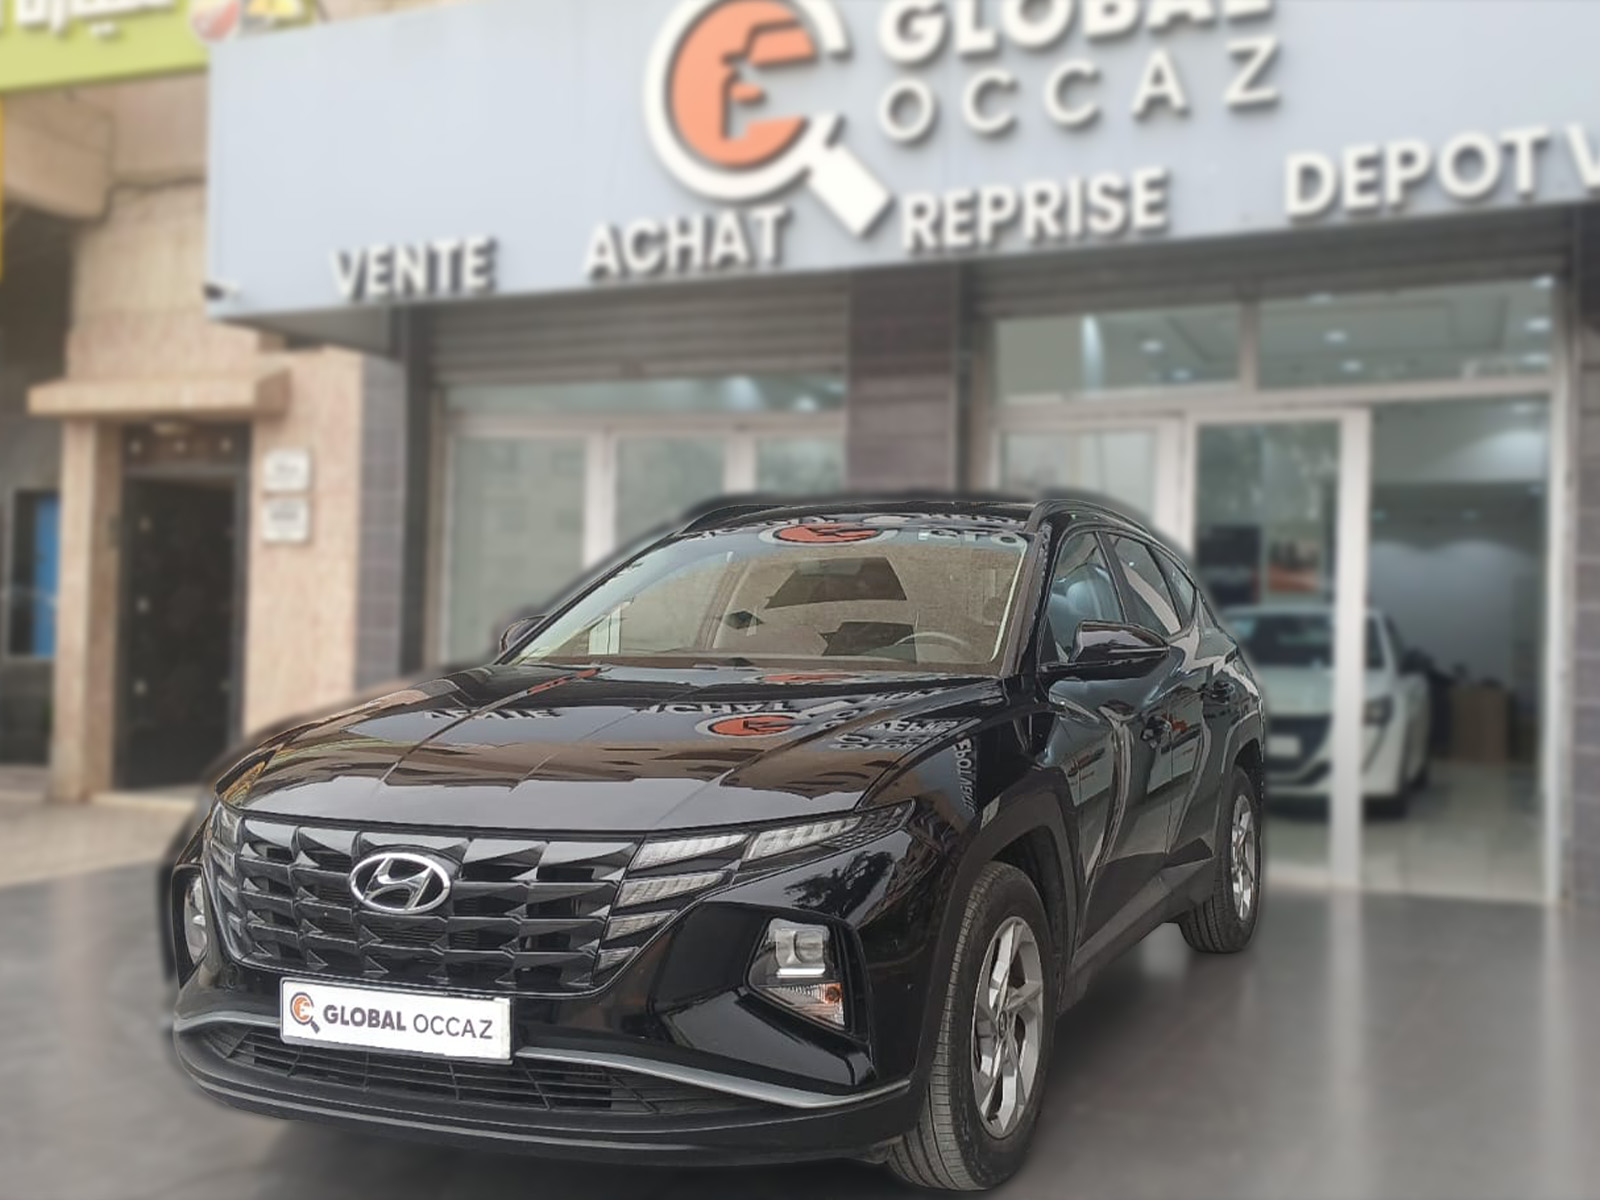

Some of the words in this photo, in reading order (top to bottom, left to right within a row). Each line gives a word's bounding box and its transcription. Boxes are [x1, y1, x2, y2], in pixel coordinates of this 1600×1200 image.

[878, 35, 1279, 142] OCCAZ
[329, 235, 497, 298] VENTE
[585, 204, 789, 277] ACHAT
[901, 166, 1168, 250] REPRISE
[1284, 125, 1549, 218] DEPOT
[323, 1004, 406, 1031] GLOBAL
[413, 1013, 493, 1040] OCCAZ
